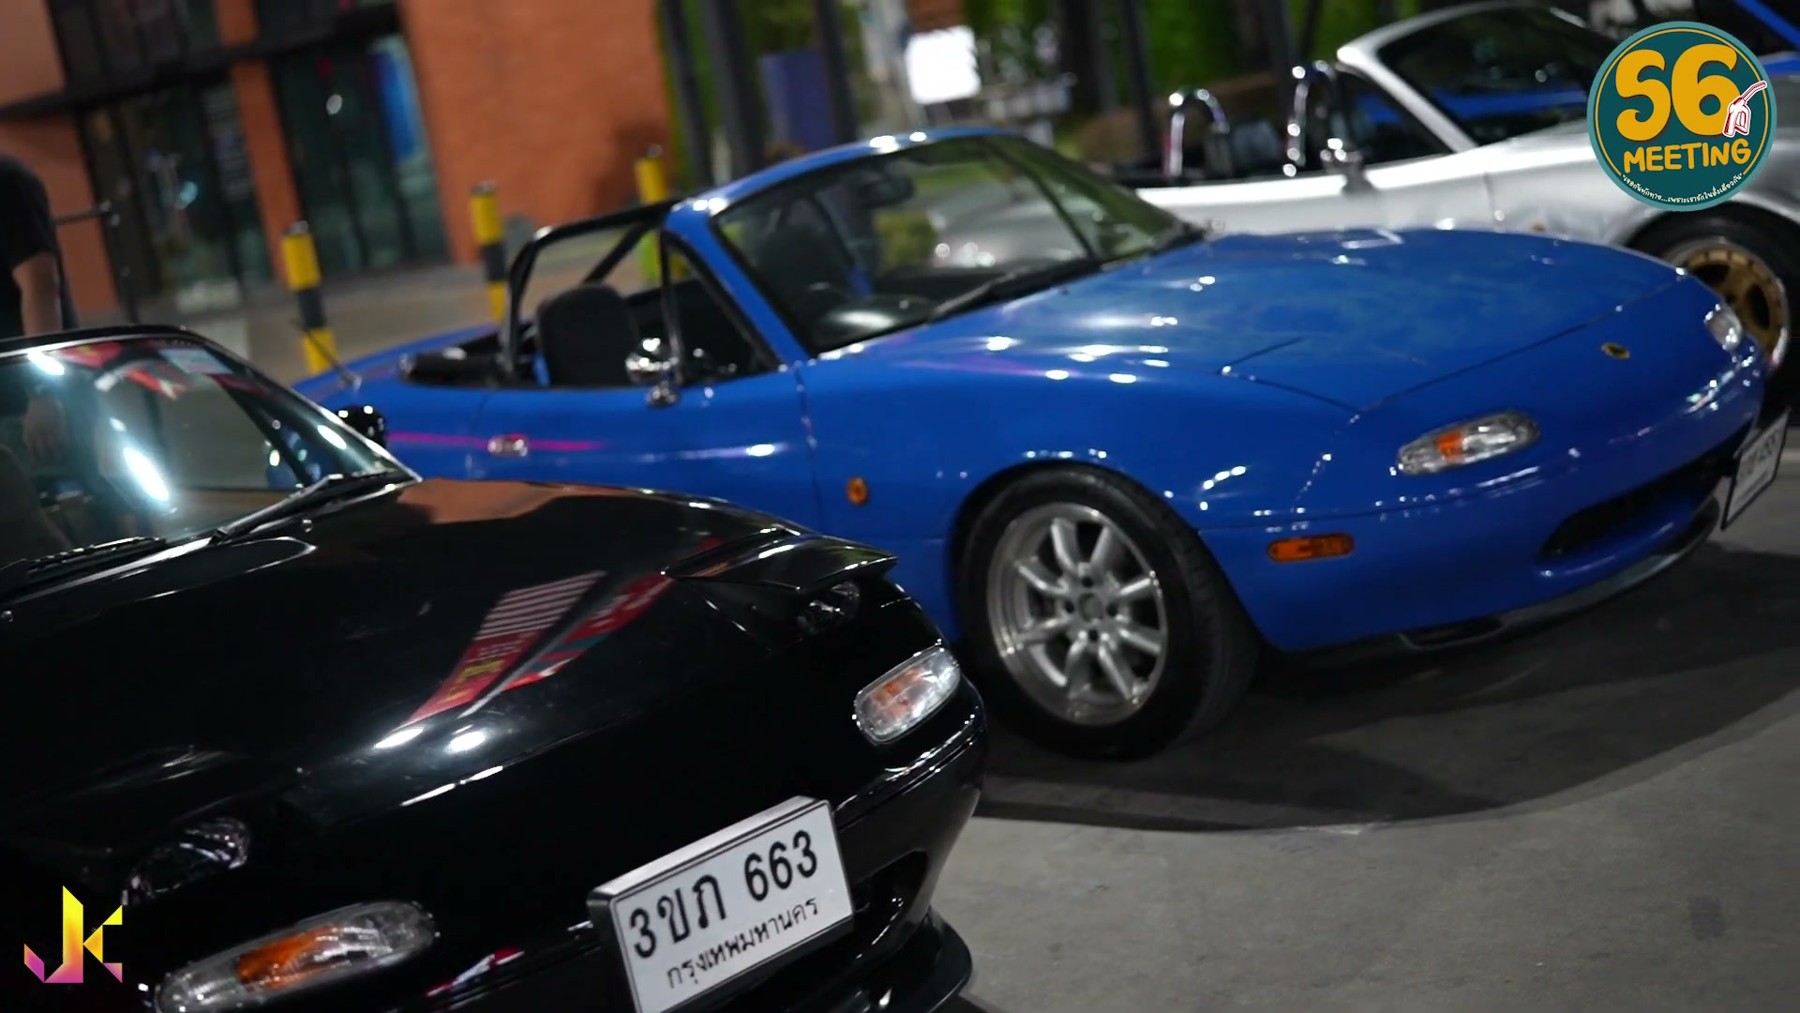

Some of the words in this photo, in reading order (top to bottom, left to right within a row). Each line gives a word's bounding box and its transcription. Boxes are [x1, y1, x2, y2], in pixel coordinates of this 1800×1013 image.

[630, 874, 727, 959] 3ขภ
[744, 830, 818, 902] 663
[667, 898, 819, 988] กรุงเทพมหานคร
